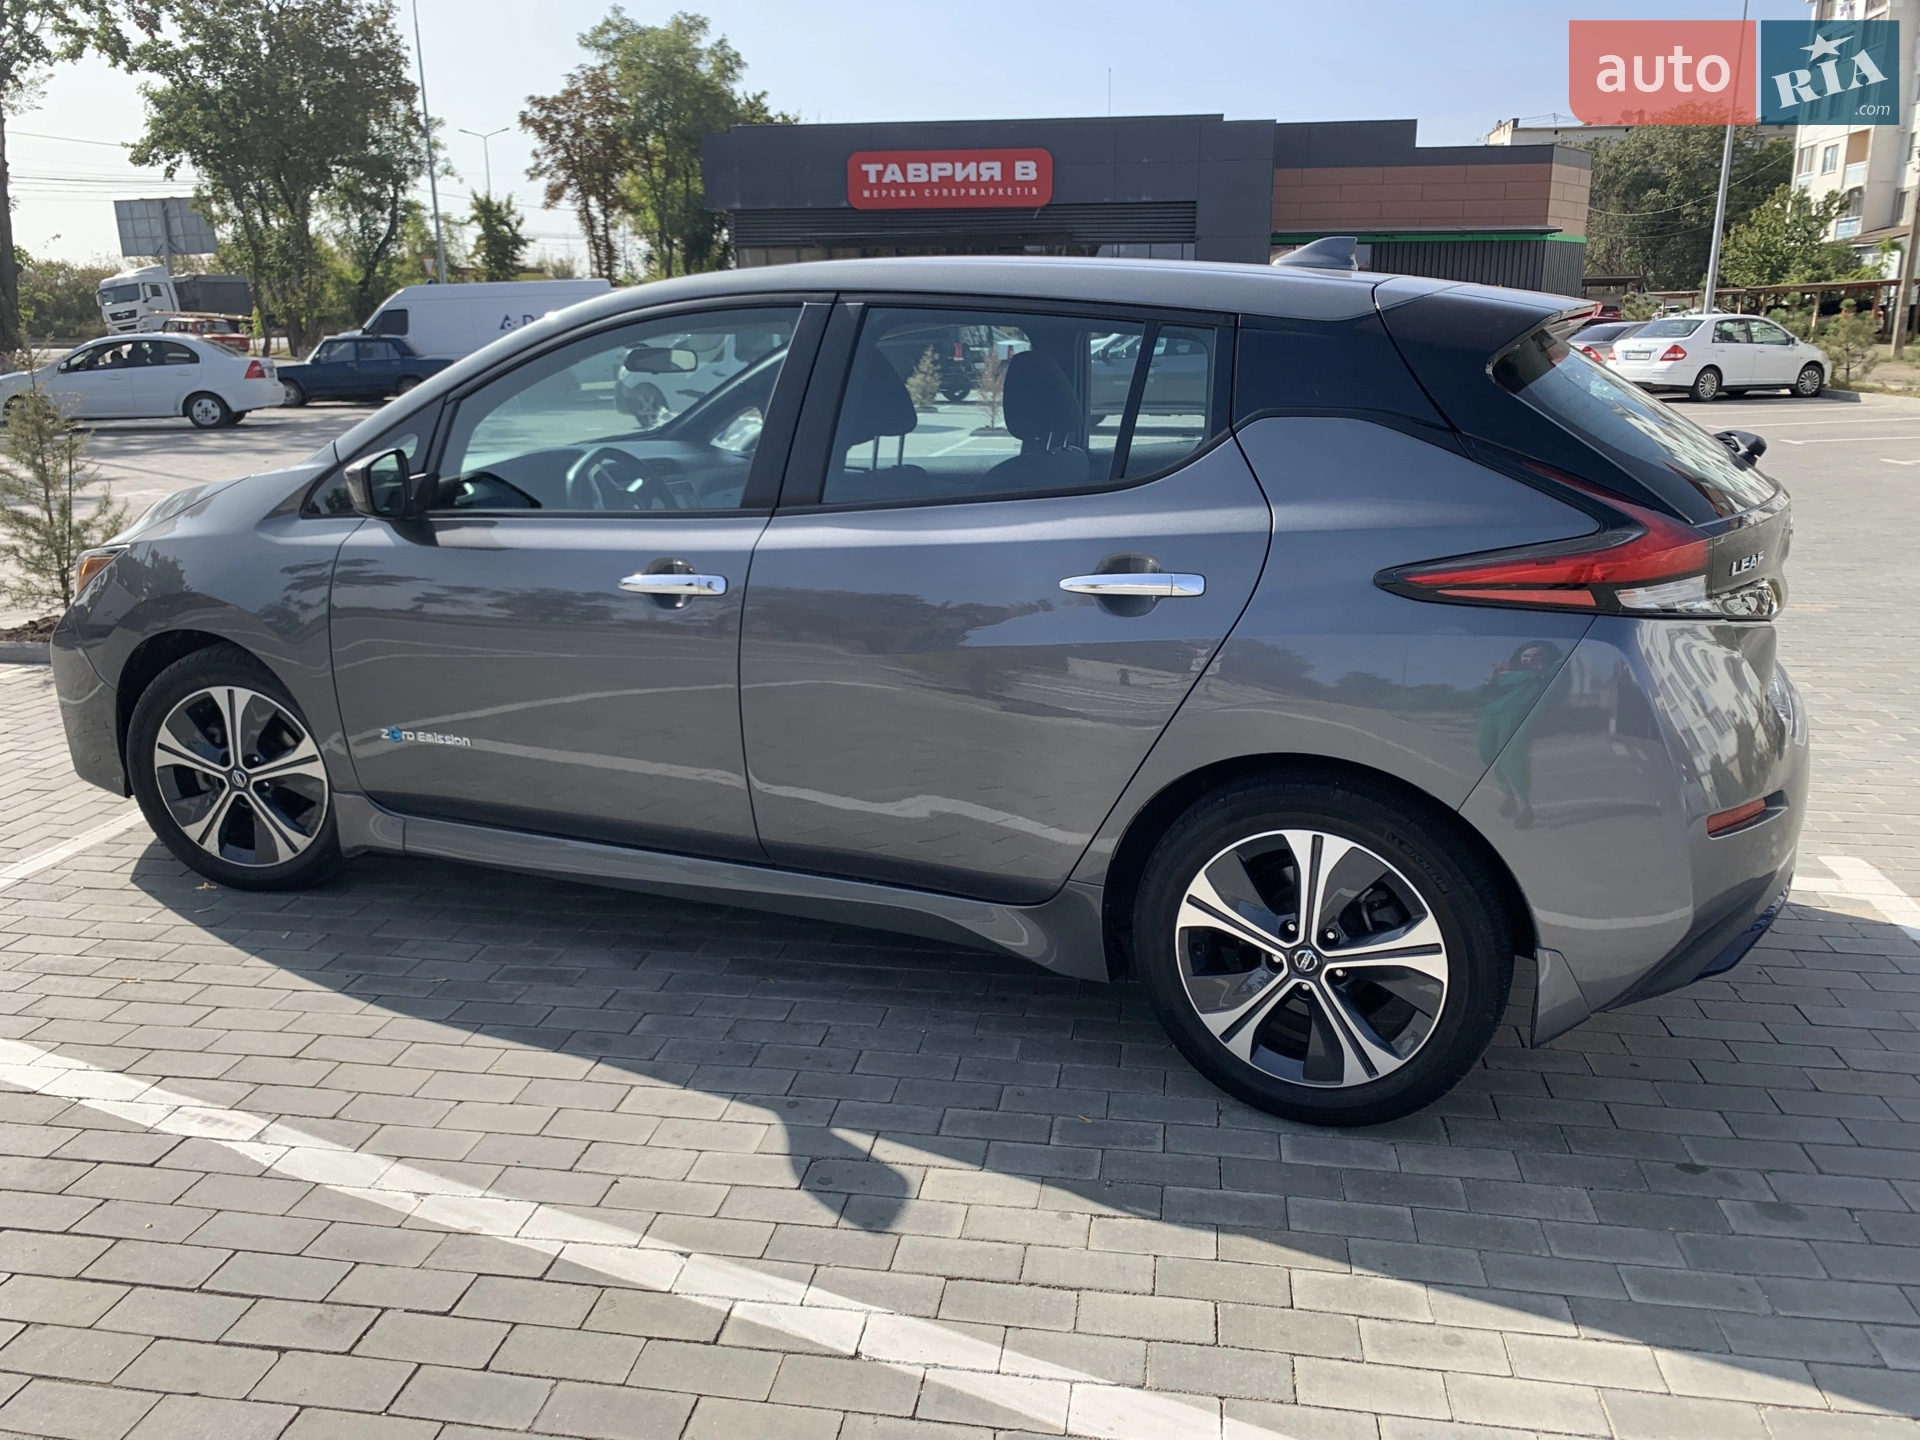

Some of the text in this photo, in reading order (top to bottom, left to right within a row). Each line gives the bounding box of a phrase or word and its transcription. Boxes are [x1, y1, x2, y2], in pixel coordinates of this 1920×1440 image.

[861, 160, 1038, 184] ТАВРИЯ В
[862, 187, 1038, 198] МЕРЕЖА СУПЕРМАРКЕТІВ
[1730, 551, 1765, 576] LEAF
[417, 731, 472, 747] Emission
